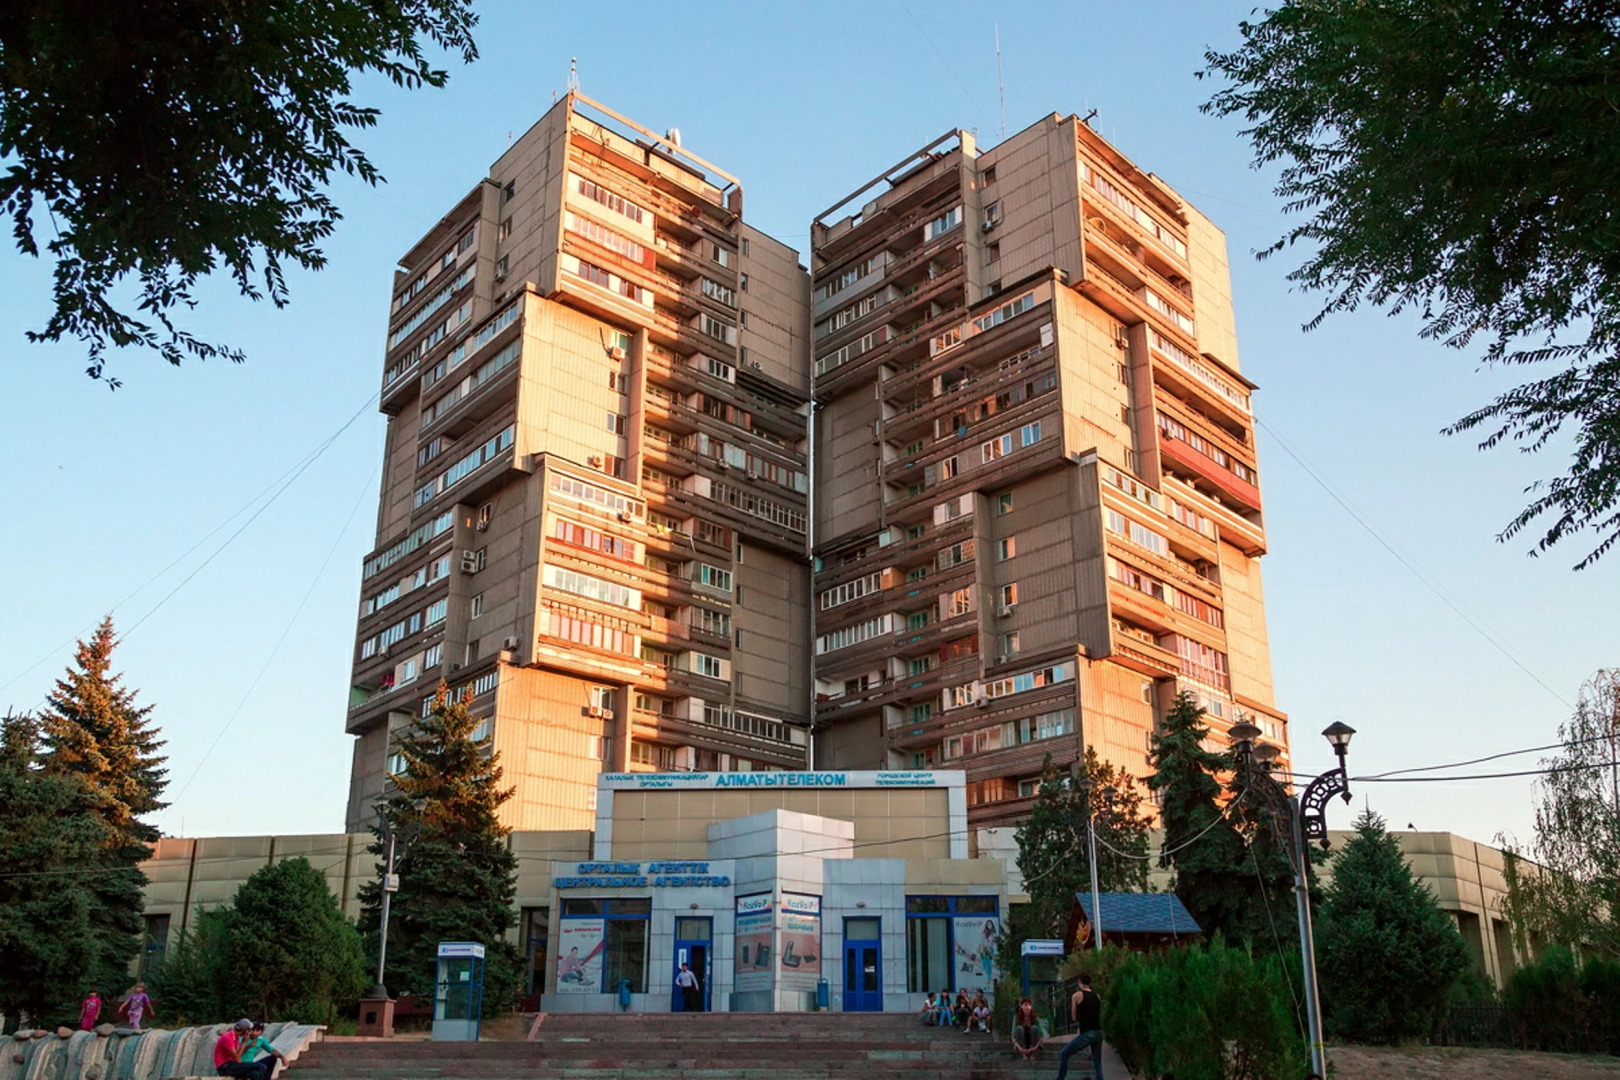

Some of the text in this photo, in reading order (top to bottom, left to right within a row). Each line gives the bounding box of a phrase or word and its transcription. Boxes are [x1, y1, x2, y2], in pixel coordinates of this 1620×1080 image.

[716, 774, 846, 787] АЛМАТЫТЕЛЕКОМ
[553, 876, 731, 889] ЦЕНТРАЛЬНОЕ АГЕНТСТВО
